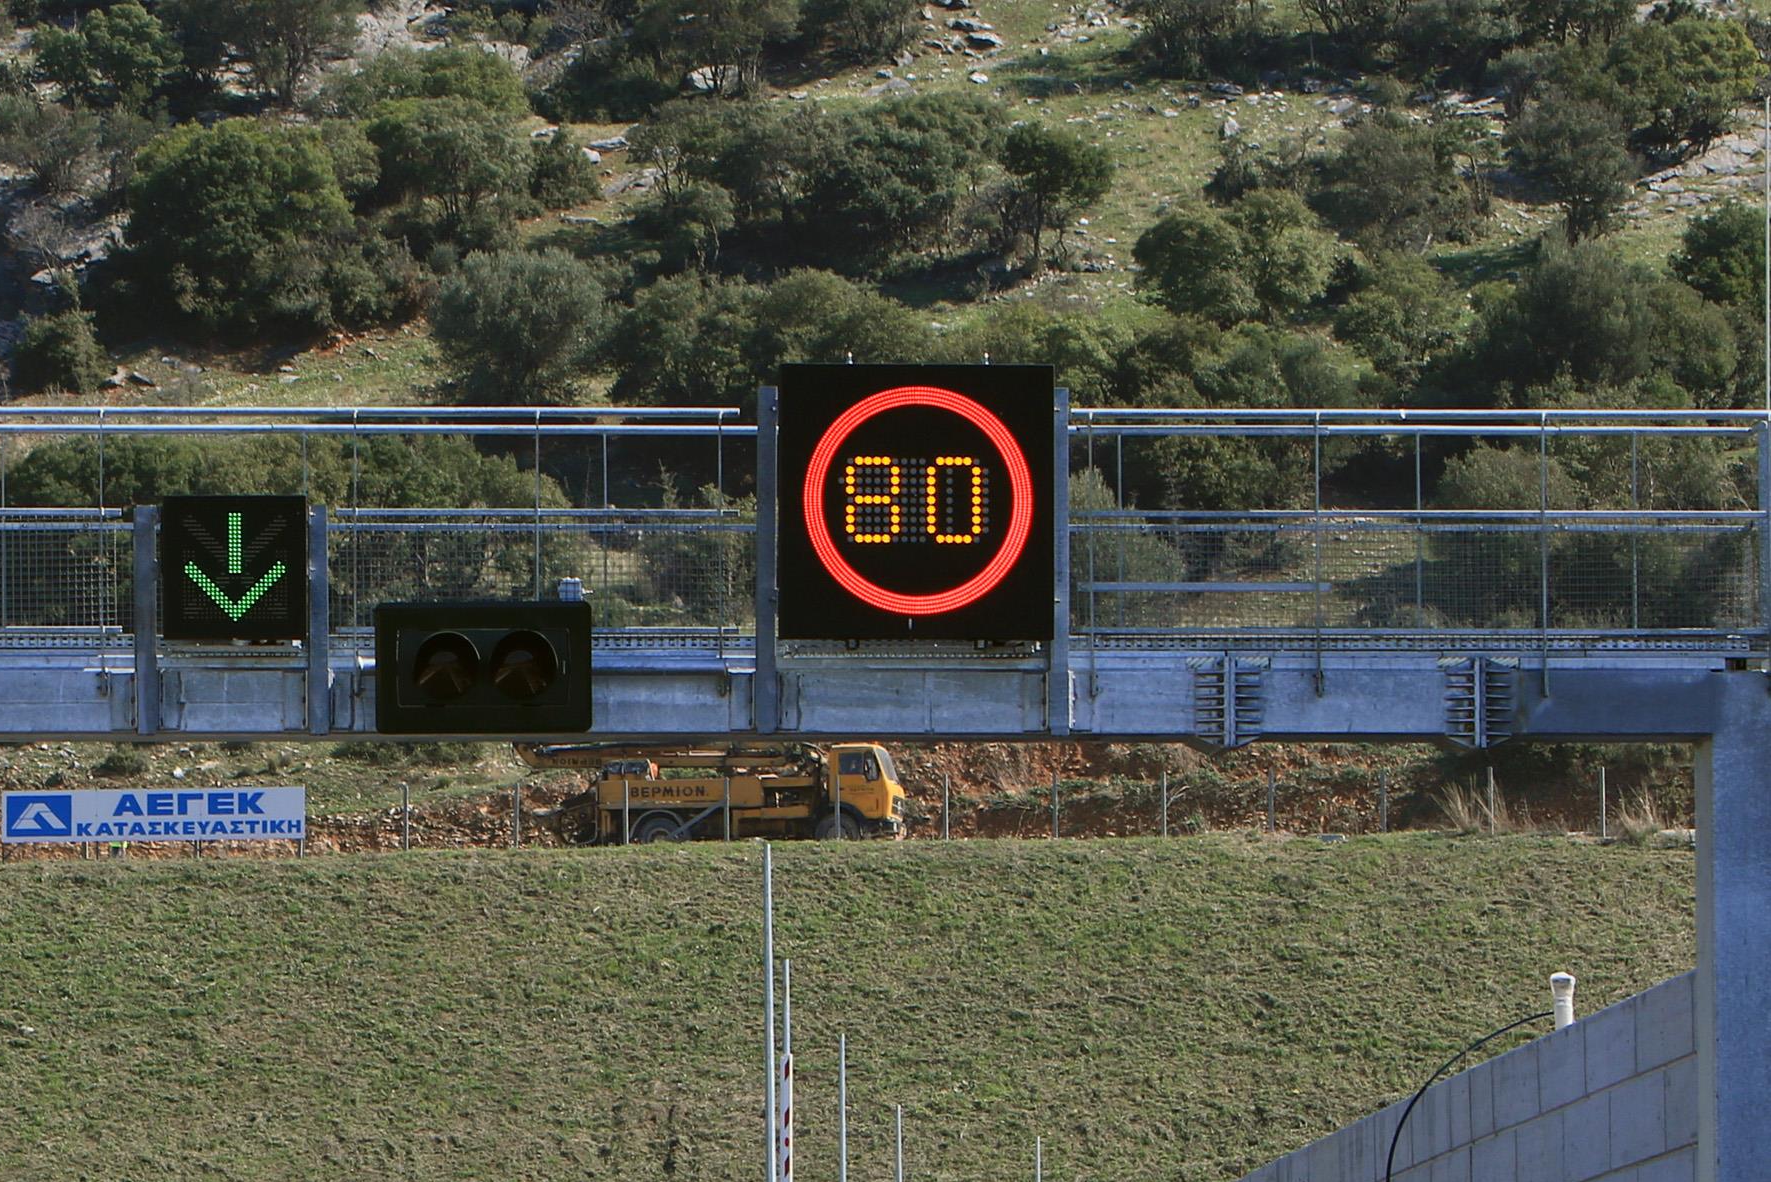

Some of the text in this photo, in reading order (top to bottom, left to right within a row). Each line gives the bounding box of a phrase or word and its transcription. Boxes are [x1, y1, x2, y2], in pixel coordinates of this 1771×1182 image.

[845, 456, 981, 544] 80
[112, 792, 265, 817] ΑΕΓΕΚ
[76, 819, 302, 837] ΚΑΤΑΣΚΕΥΑΣΤΙΚΗ
